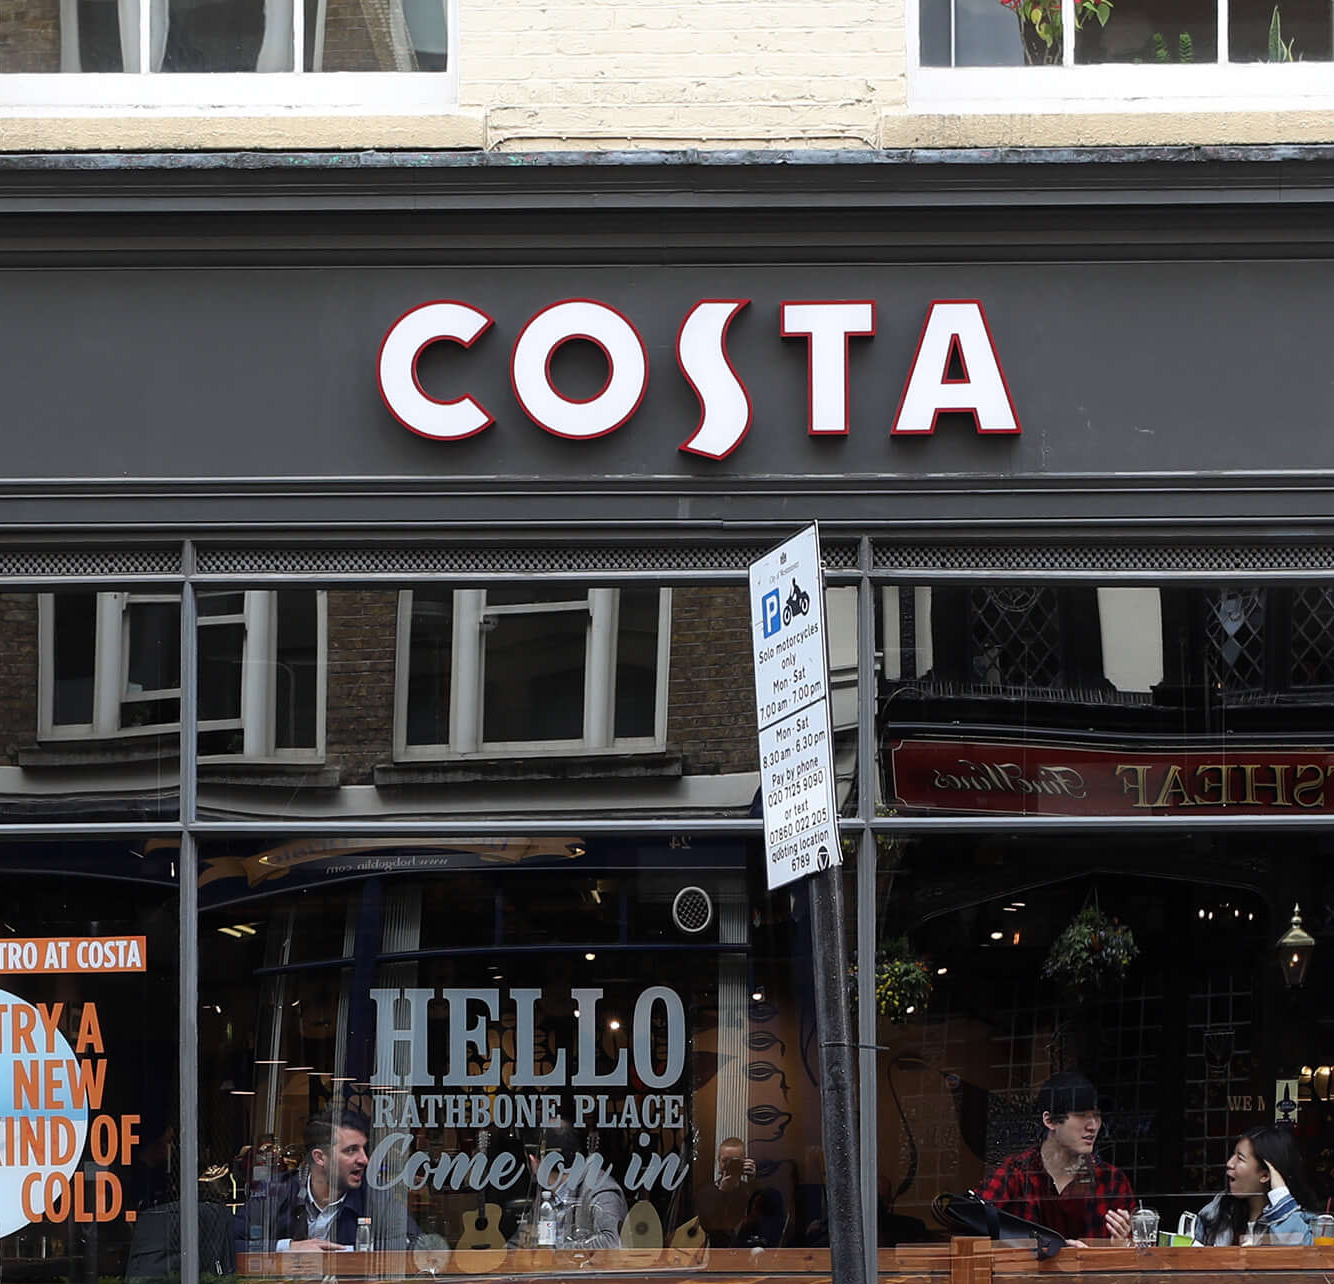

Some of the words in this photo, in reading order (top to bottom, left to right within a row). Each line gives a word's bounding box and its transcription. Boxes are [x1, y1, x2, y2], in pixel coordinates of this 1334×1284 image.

[376, 298, 1021, 461] COSTA
[759, 647, 774, 665] Solo
[776, 622, 819, 655] motorcycles
[781, 652, 796, 670] only
[773, 679, 788, 695] Mon
[793, 666, 806, 683] Sat
[760, 702, 776, 720] 7.00
[778, 698, 788, 712] am
[792, 683, 809, 704] 7.00
[810, 680, 822, 697] pm
[776, 727, 791, 743] Mon
[796, 716, 809, 733] Sat
[762, 752, 779, 769] 8.30
[780, 748, 791, 761] am
[795, 734, 813, 752] 6.30
[814, 729, 826, 747] pm
[768, 789, 783, 808] 020
[785, 783, 801, 801] 7125
[803, 771, 823, 791] 9090
[771, 770, 784, 787] Pay
[786, 765, 795, 782] by
[797, 757, 819, 777] phone
[769, 823, 793, 845] 07860
[795, 816, 811, 833] 022
[812, 808, 827, 826] 205
[784, 807, 793, 820] or
[794, 799, 809, 816] text
[771, 842, 798, 863] quoting
[799, 830, 830, 850] location
[791, 853, 811, 873] 6789
[44, 941, 72, 969] AT
[76, 940, 142, 969] COSTA
[75, 1002, 105, 1054] A
[369, 985, 687, 1089] HELLO
[12, 1059, 107, 1110] NEW
[372, 1094, 561, 1130] RATHBONE
[573, 1094, 685, 1130] PLACE
[90, 1114, 141, 1166] OF
[366, 1132, 526, 1192] Come
[534, 1153, 617, 1192] on
[623, 1133, 690, 1193] in
[21, 1171, 137, 1223] COLD.
